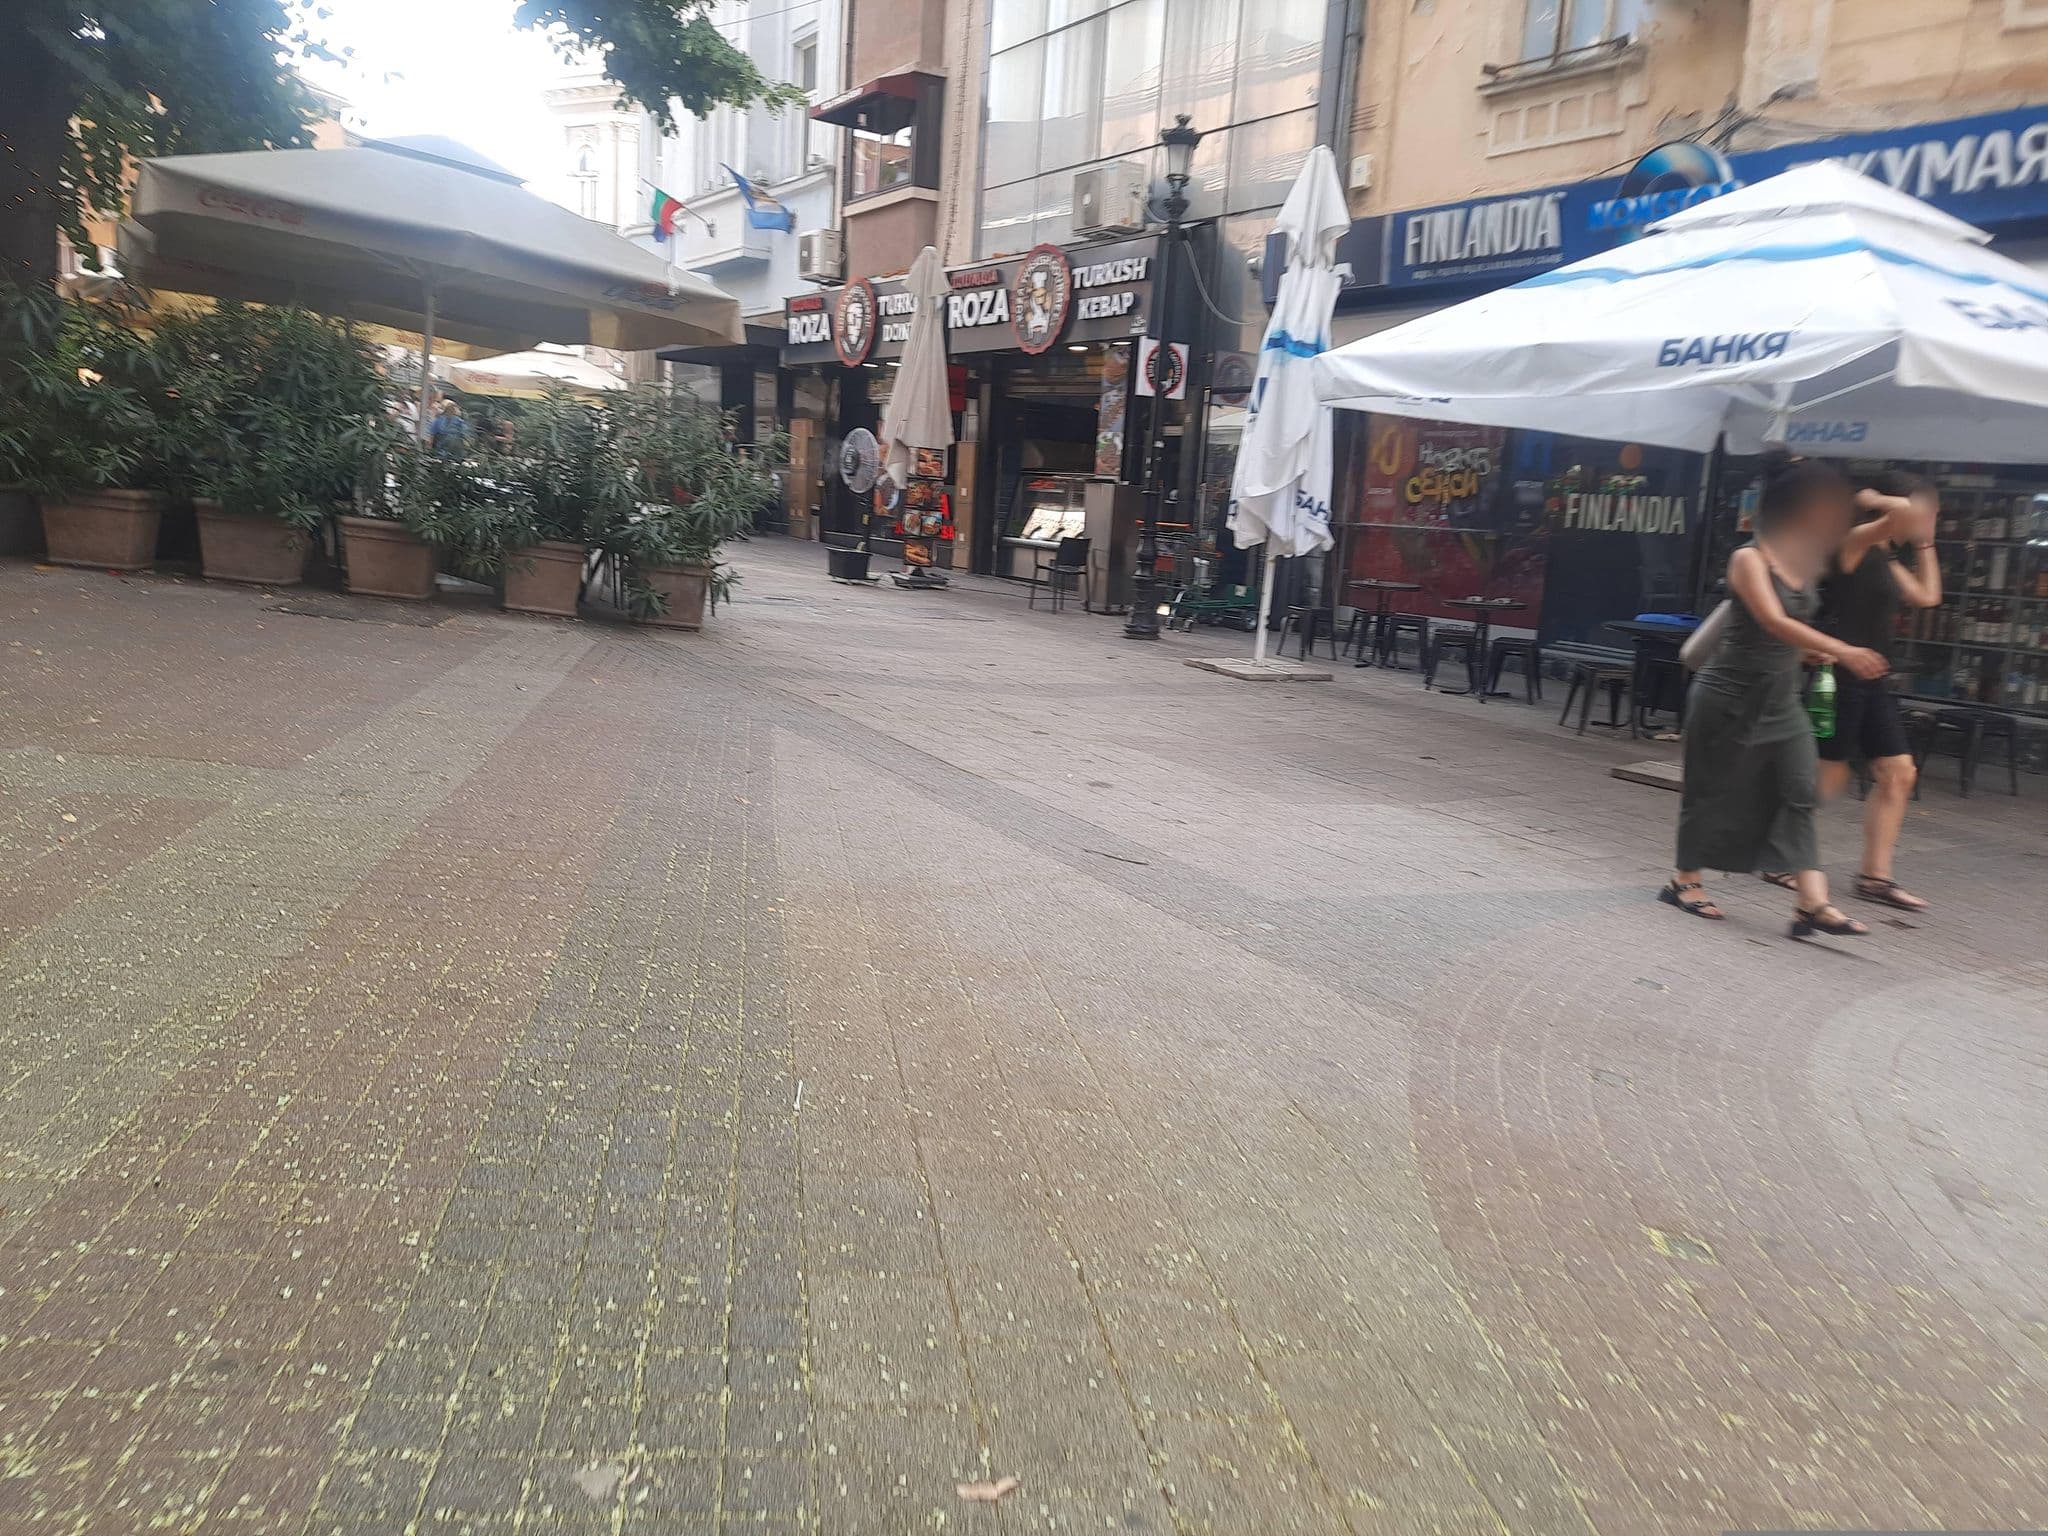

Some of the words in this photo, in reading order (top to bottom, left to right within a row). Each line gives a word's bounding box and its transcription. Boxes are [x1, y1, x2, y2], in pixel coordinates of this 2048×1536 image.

[1404, 196, 1563, 266] FINLANDIA
[1072, 256, 1149, 289] TURKISH
[948, 288, 1010, 329] ROZA
[1077, 291, 1135, 320] KEBAP
[788, 313, 831, 345] ROZA
[1656, 331, 1792, 367] БАНКЯ
[1564, 493, 1687, 534] FINLANDIA
